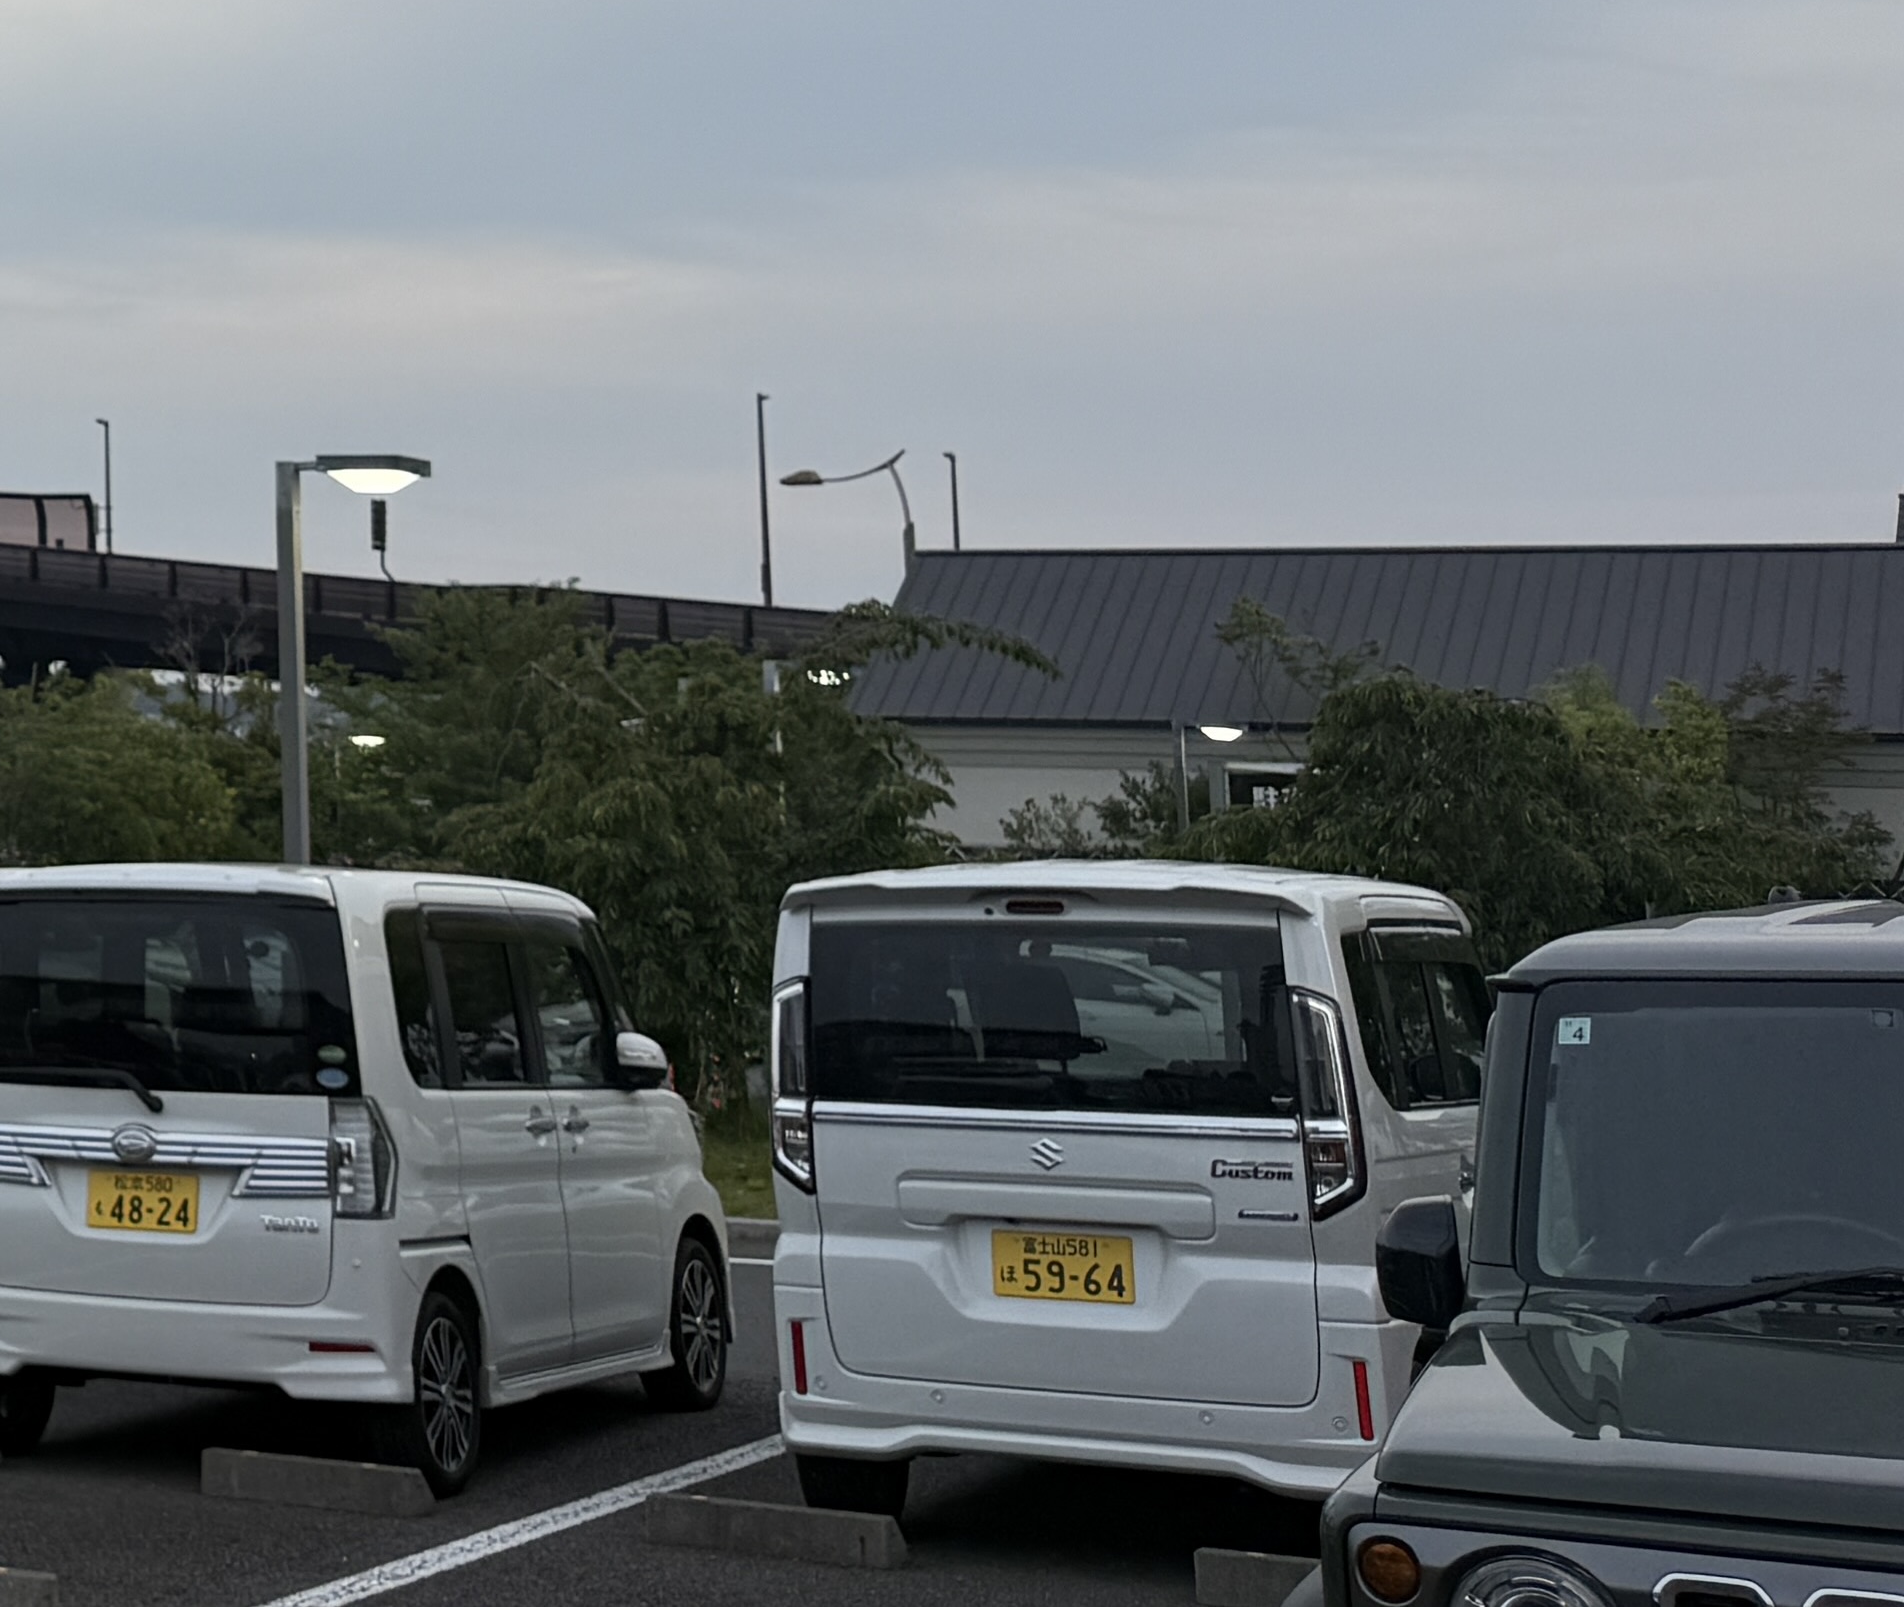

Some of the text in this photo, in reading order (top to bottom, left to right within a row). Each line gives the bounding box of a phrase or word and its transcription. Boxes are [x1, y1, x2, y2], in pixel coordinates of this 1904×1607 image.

[1572, 1026, 1584, 1042] 4
[1211, 1159, 1294, 1181] Custom
[110, 1194, 189, 1228] 48-24
[1022, 1236, 1098, 1258] 富士山581
[1000, 1258, 1126, 1298] ほ 59-64
